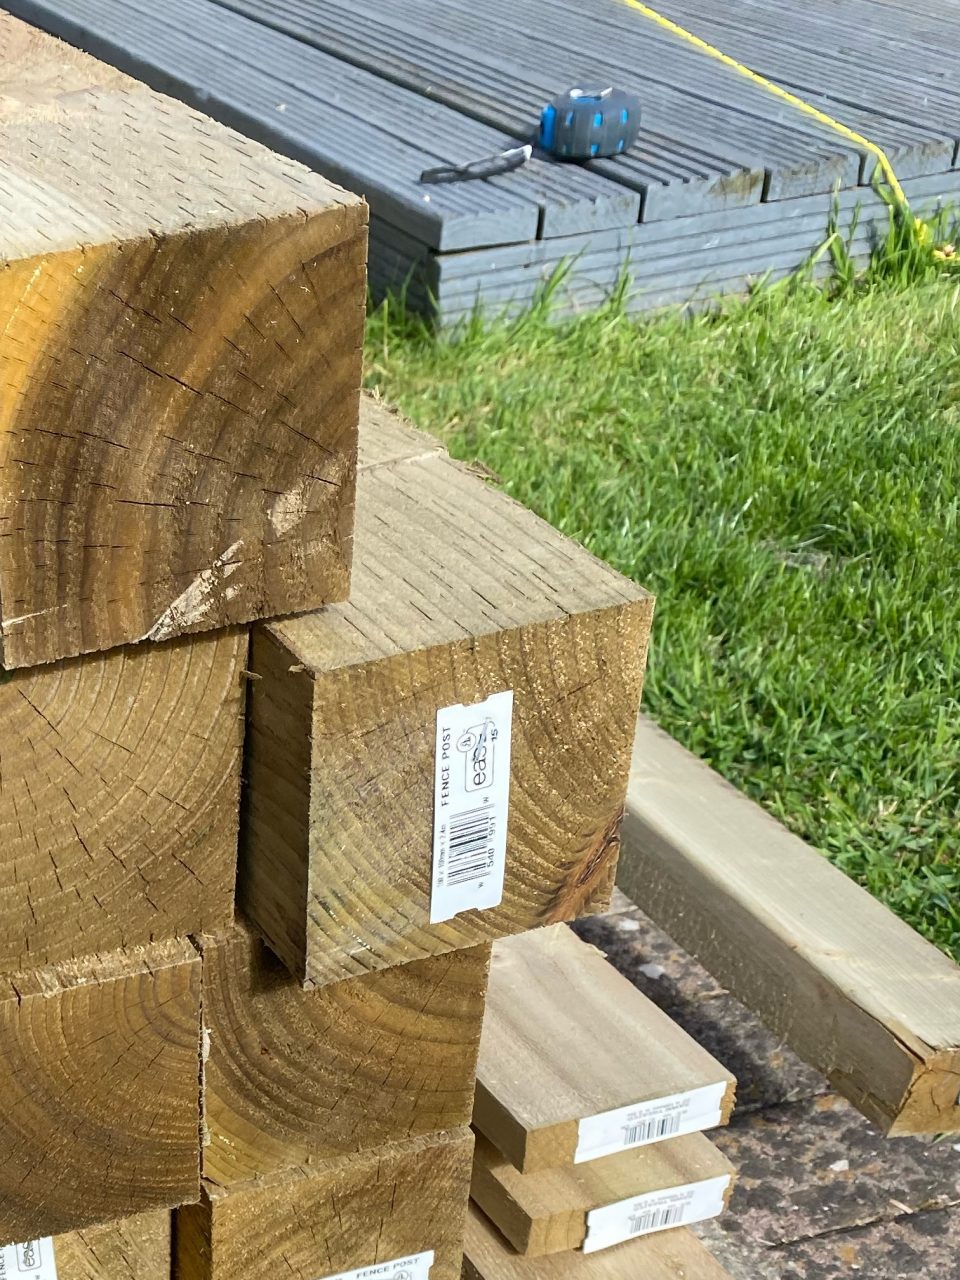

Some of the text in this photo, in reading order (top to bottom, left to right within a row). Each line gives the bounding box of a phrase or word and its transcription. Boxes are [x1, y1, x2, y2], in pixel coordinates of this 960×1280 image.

[441, 727, 450, 806] FENCE POST
[486, 847, 494, 867] 540
[356, 1257, 419, 1278] FENCE POST
